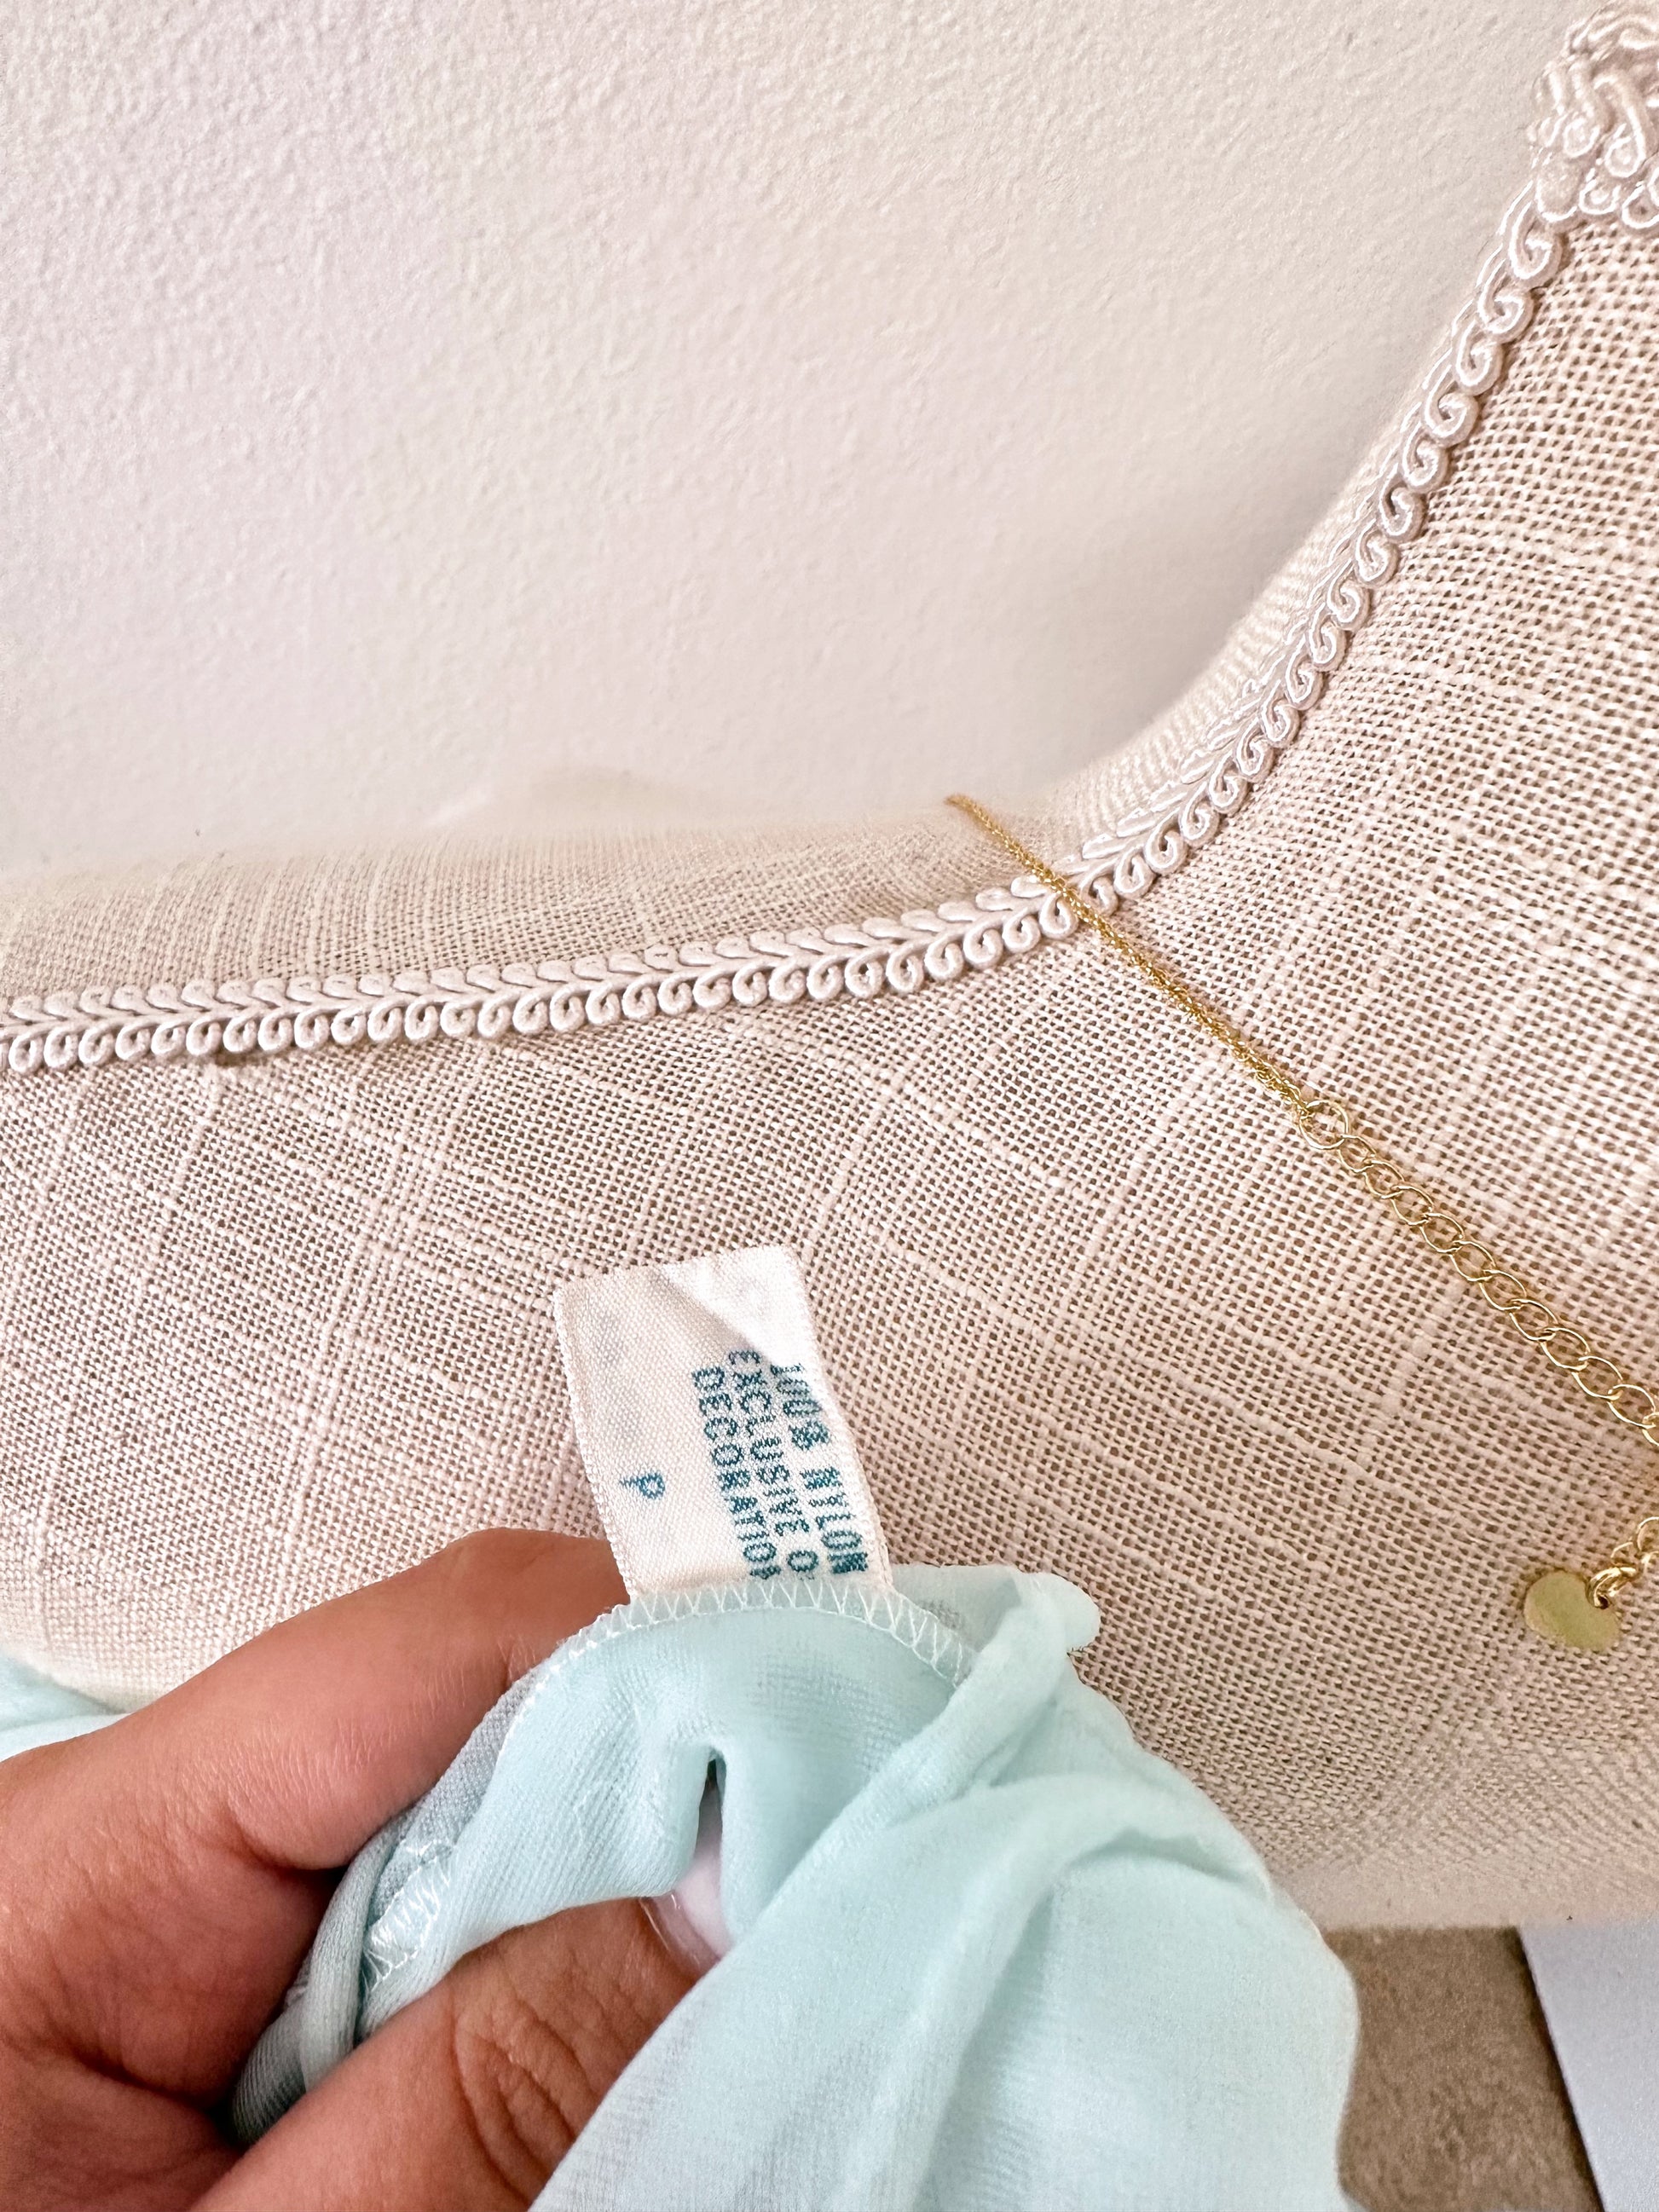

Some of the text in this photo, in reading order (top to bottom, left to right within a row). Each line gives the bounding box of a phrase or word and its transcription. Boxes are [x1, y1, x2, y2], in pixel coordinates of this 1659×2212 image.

[619, 1471, 666, 1500] P
[728, 1349, 819, 1580] EXCLUSIVE O
[800, 1467, 869, 1574] NYLON
